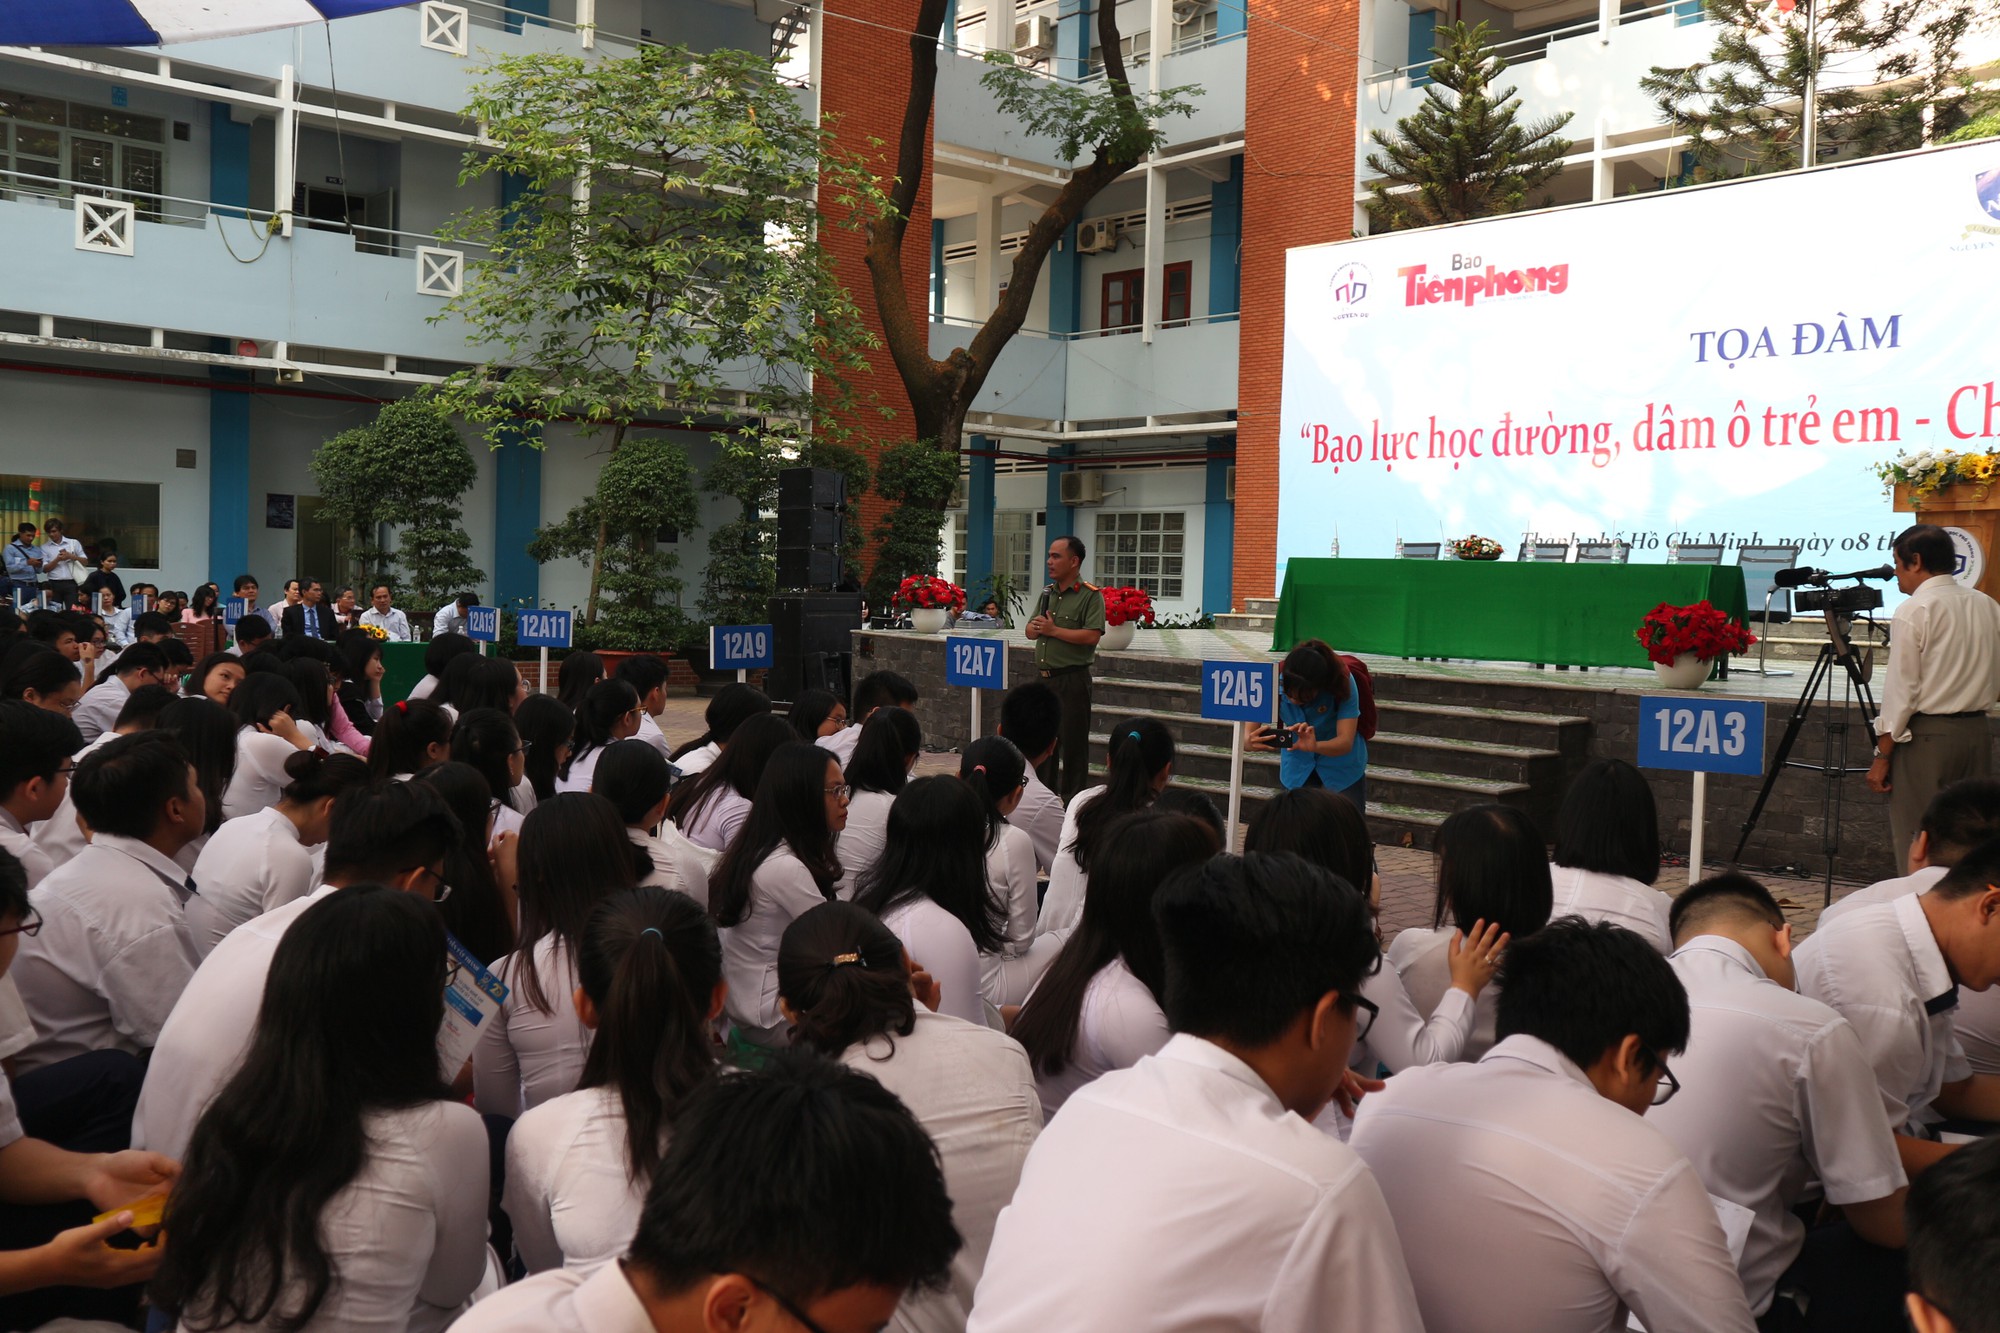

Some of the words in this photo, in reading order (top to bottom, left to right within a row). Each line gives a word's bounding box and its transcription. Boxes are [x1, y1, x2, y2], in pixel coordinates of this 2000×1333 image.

[1690, 326, 1779, 369] TỌA
[1791, 311, 1903, 355] ĐÀM
[1370, 418, 1419, 472] lực
[1427, 415, 1484, 470] học
[1492, 411, 1620, 468] đường,
[1633, 402, 1716, 452] dâm
[1727, 399, 1750, 448] ô
[1762, 394, 1821, 446] trẻ
[1832, 406, 1902, 444] em
[1630, 530, 1659, 550] Hồ
[1779, 532, 1835, 557] ngày
[469, 610, 495, 633] 12A13
[521, 614, 566, 639] 12A11
[722, 631, 766, 660] 12A9
[953, 644, 996, 677] 12A7
[1211, 669, 1263, 708] 12A5
[1655, 708, 1746, 756] 12A3
